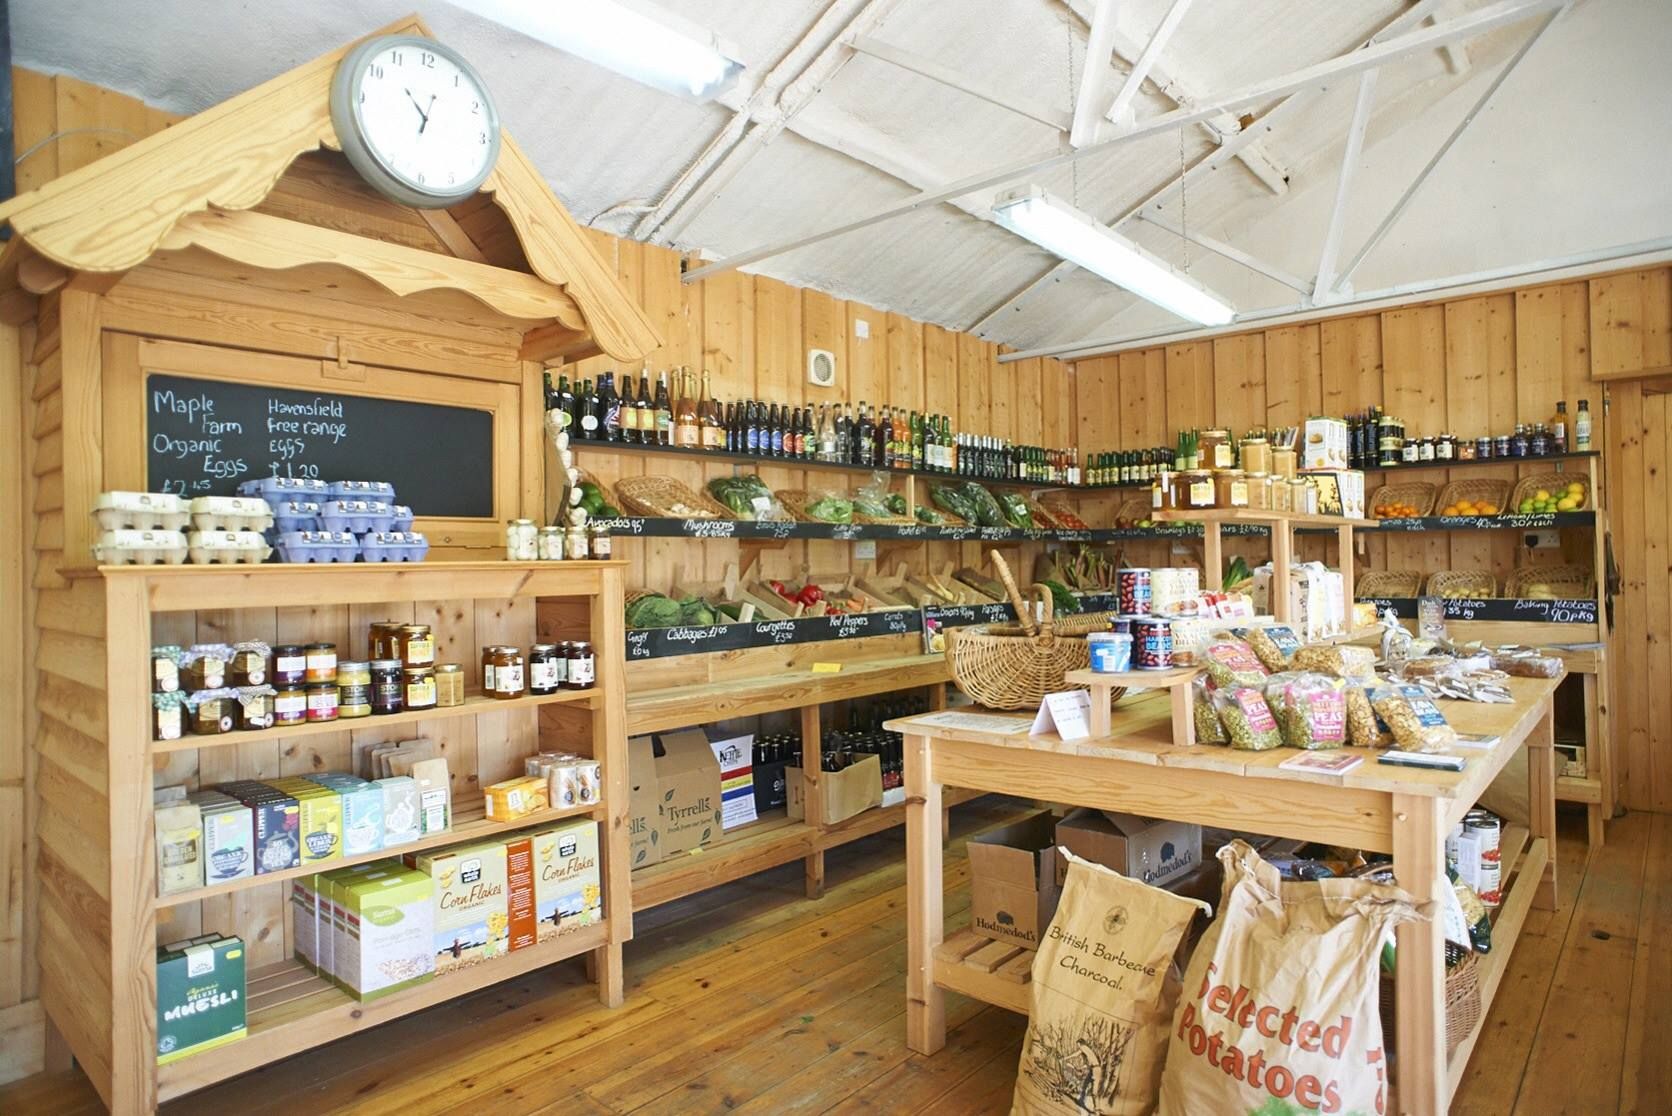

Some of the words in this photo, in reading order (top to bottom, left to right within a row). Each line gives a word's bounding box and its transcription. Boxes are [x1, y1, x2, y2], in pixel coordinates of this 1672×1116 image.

[391, 51, 403, 66] 11
[420, 52, 435, 69] 12
[368, 63, 384, 79] 10
[471, 101, 479, 115] 2
[154, 390, 215, 423] Maple
[202, 413, 243, 435] Farm
[303, 420, 347, 444] range
[153, 433, 222, 458] Organic
[203, 455, 248, 478] Eggs
[1513, 601, 1550, 616] Baking
[1552, 600, 1597, 611] Potatoes
[1313, 711, 1344, 722] PEAS
[542, 863, 566, 882] Corn
[566, 856, 595, 875] Flakes
[440, 890, 469, 910] Corn
[470, 883, 502, 904] Flakes
[976, 916, 1036, 942] Hodmedod's
[1049, 926, 1089, 953] British
[1092, 942, 1156, 977] Barbecue
[1197, 961, 1352, 1059] Selected
[1177, 1001, 1342, 1114] Potatoes
